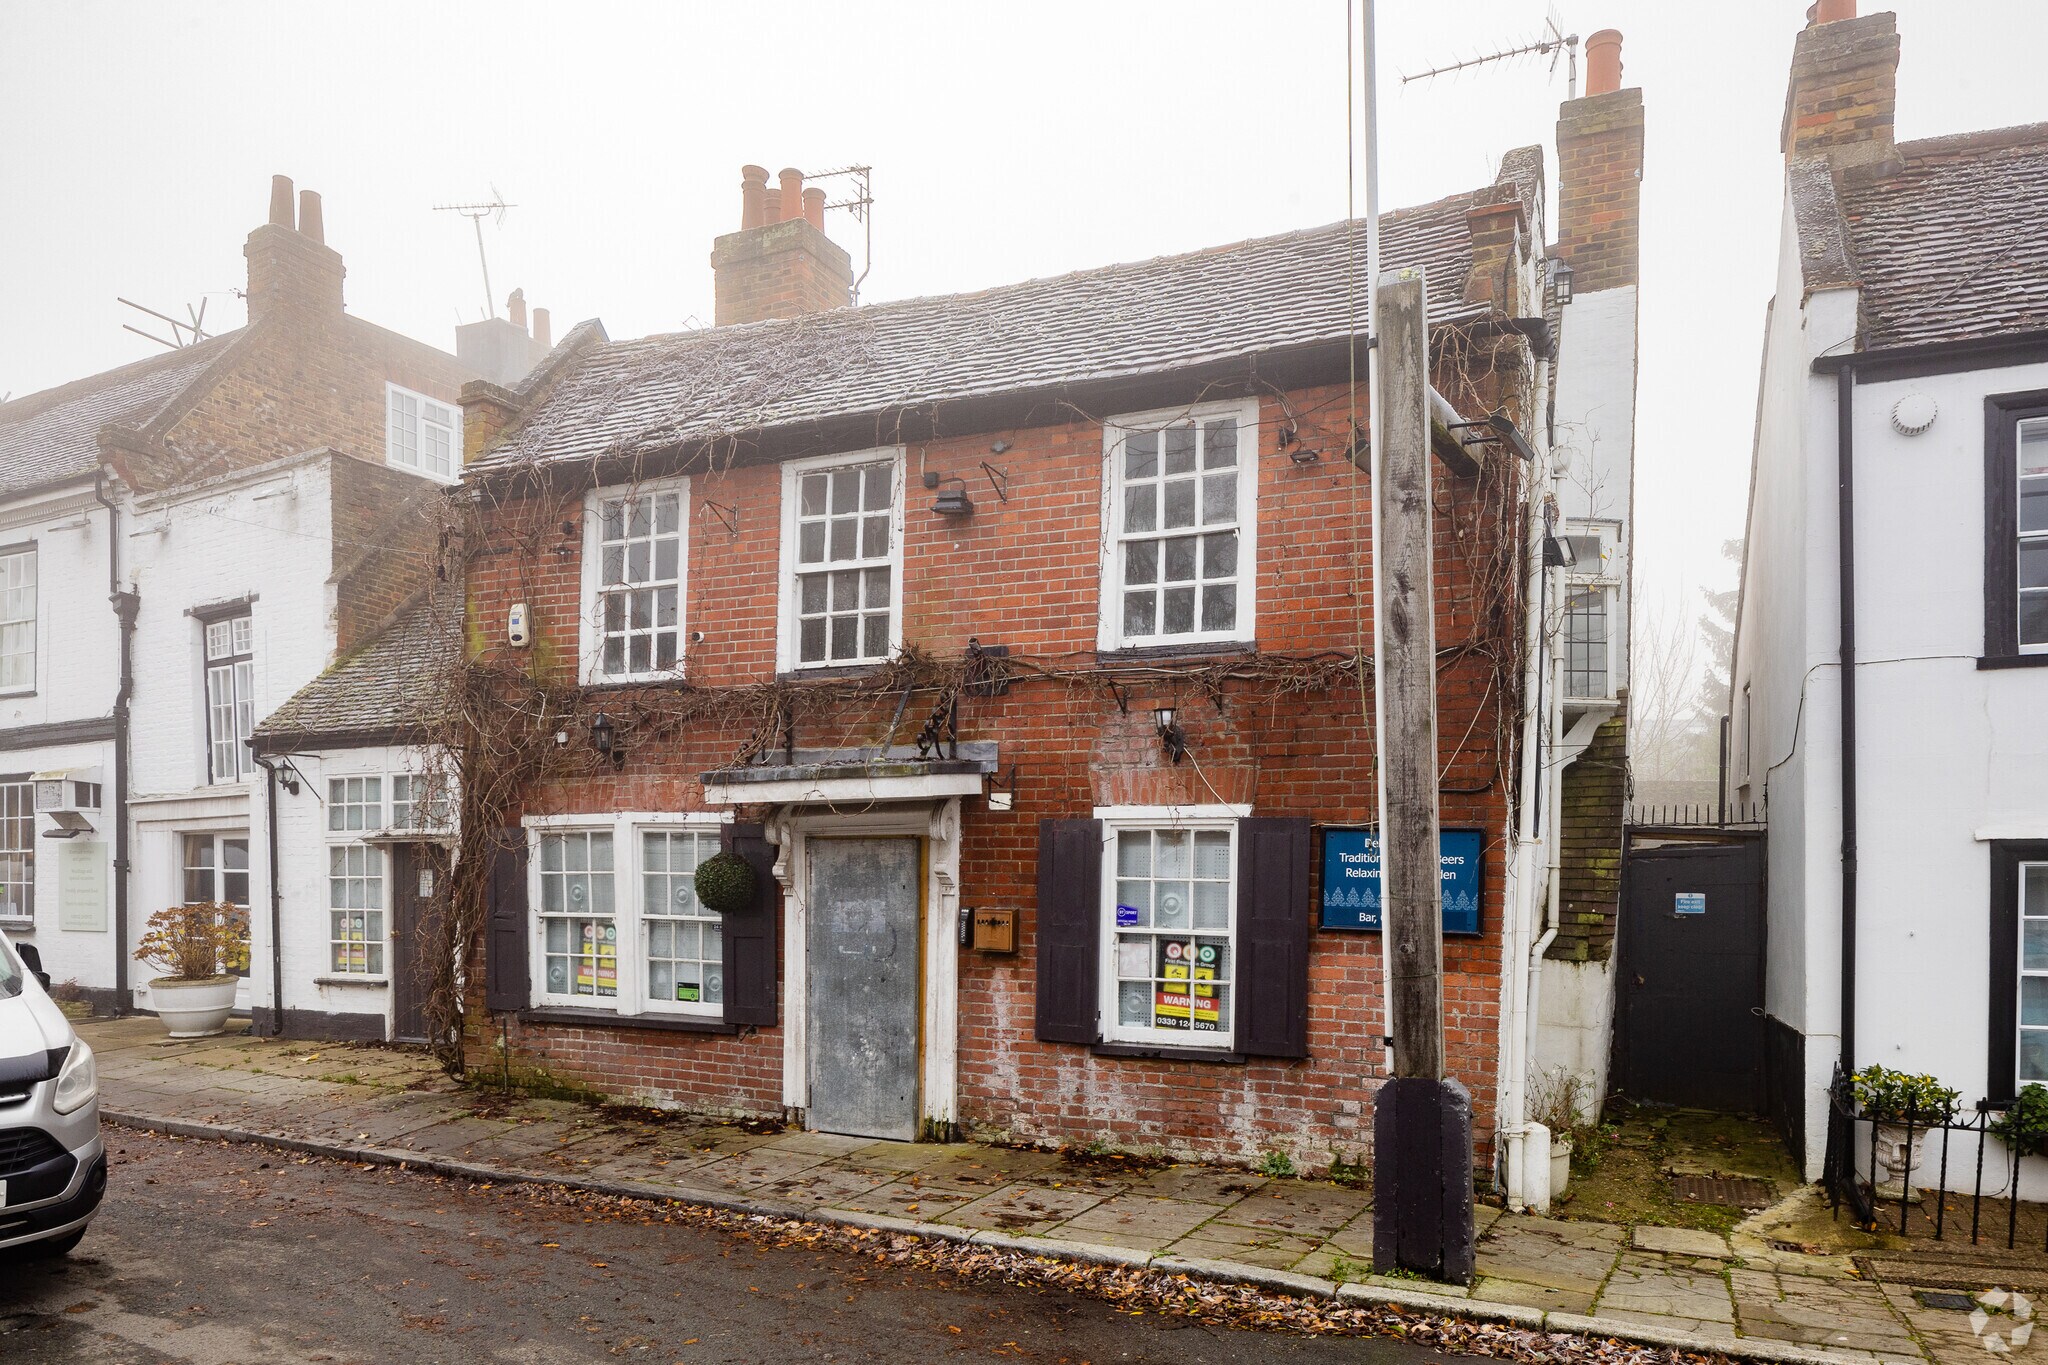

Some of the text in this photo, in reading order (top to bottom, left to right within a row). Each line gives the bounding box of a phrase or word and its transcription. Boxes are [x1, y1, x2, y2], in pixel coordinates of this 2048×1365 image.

[1339, 852, 1380, 863] Tradition
[1345, 867, 1381, 878] Relaxin
[1359, 912, 1377, 924] Bar,
[583, 968, 615, 978] WANING
[1163, 995, 1211, 1009] WARNNG
[1157, 1017, 1177, 1026] 0330
[1195, 1021, 1215, 1030] 5670
